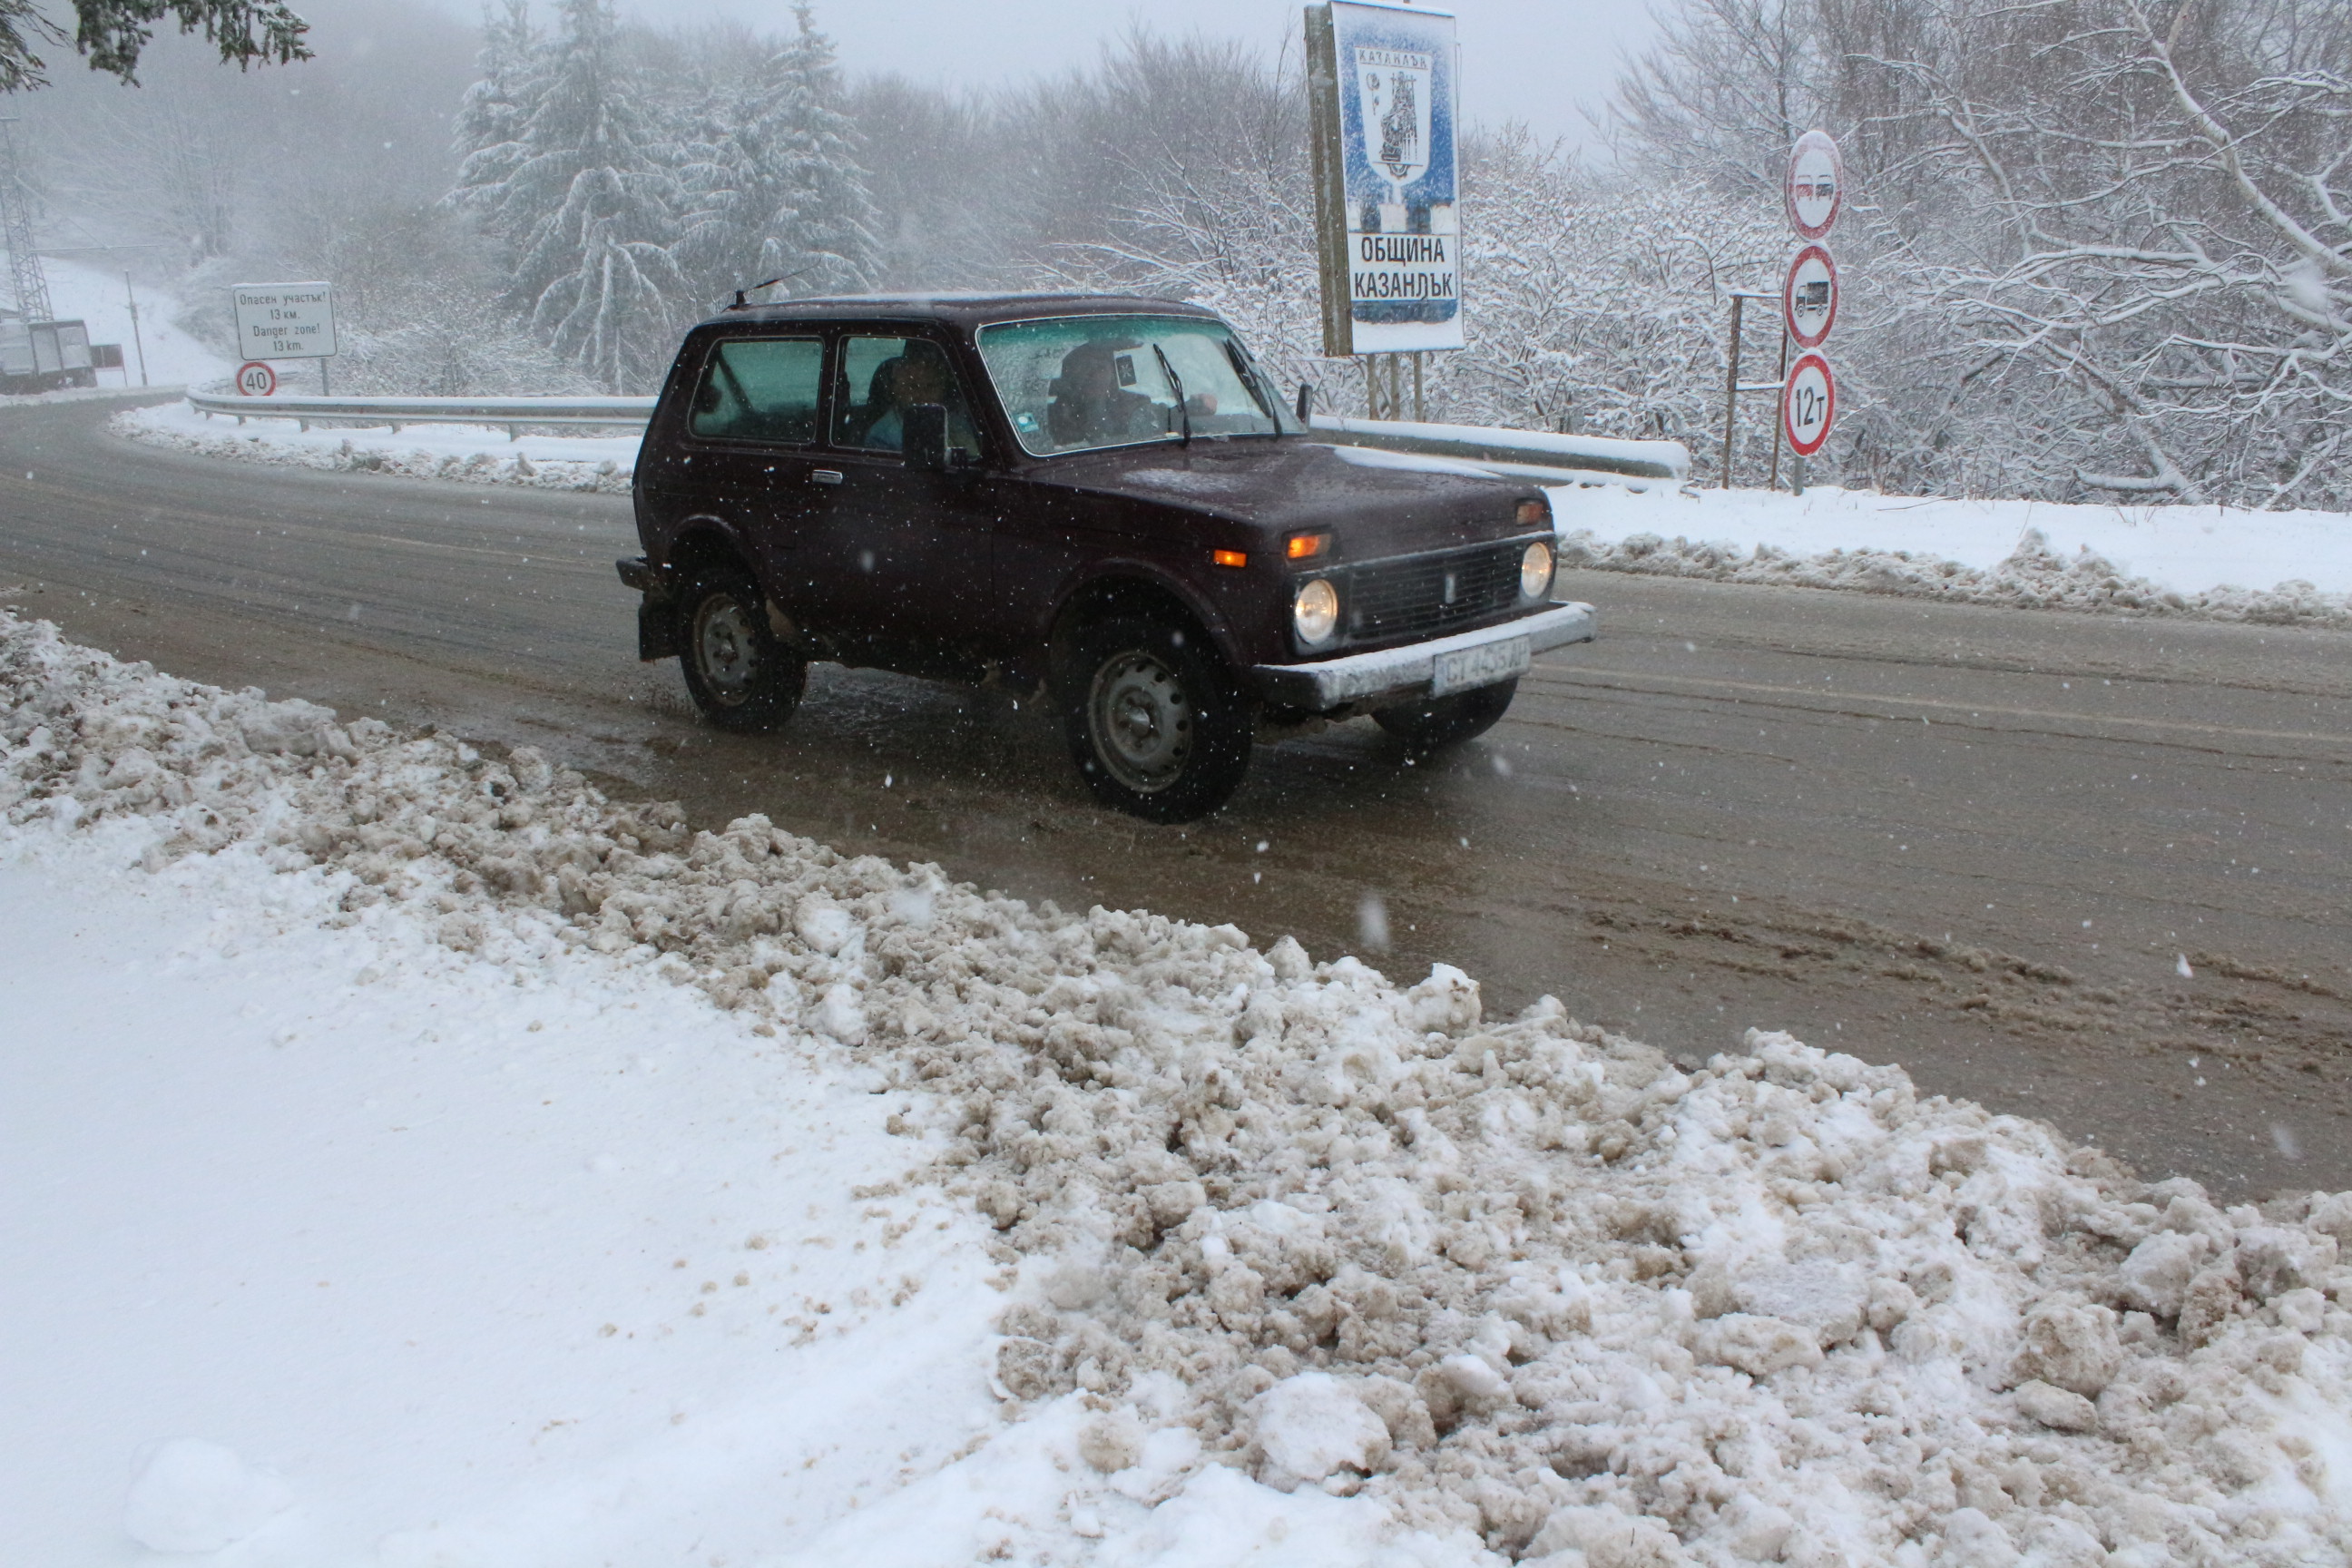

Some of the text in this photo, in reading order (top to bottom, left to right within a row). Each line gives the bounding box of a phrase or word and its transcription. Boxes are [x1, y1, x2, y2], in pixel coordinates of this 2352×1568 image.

[1361, 236, 1445, 267] ОБЩИНА
[1355, 272, 1453, 300] КАЗАНЛЪК
[240, 291, 326, 306] Опасен участък!
[270, 309, 300, 319] 13 км.
[253, 323, 320, 338] Danger zone!
[273, 340, 304, 351] 13 km.
[246, 371, 267, 390] 40
